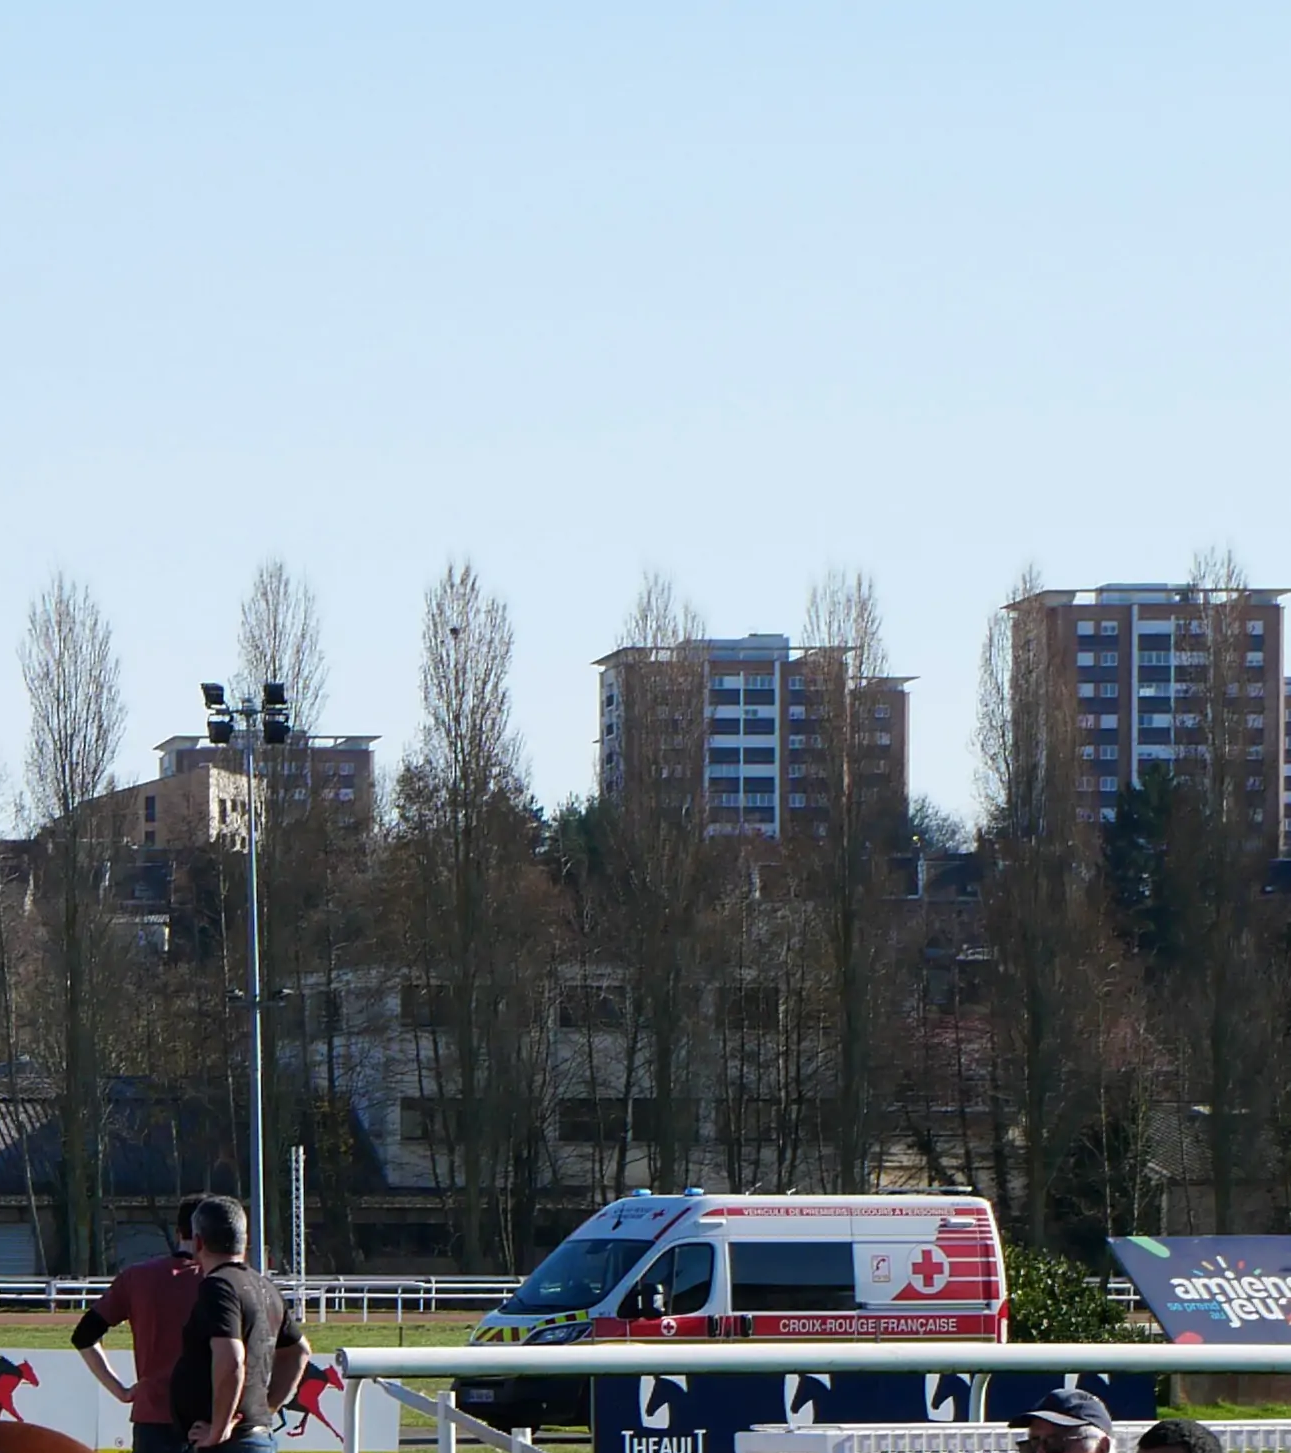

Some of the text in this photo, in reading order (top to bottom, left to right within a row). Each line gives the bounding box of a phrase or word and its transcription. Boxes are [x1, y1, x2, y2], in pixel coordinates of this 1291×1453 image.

[1169, 1270, 1291, 1300] amien
[1167, 1301, 1221, 1312] se prend
[779, 1318, 958, 1335] CROIX-ROUGE FRANÇAISE
